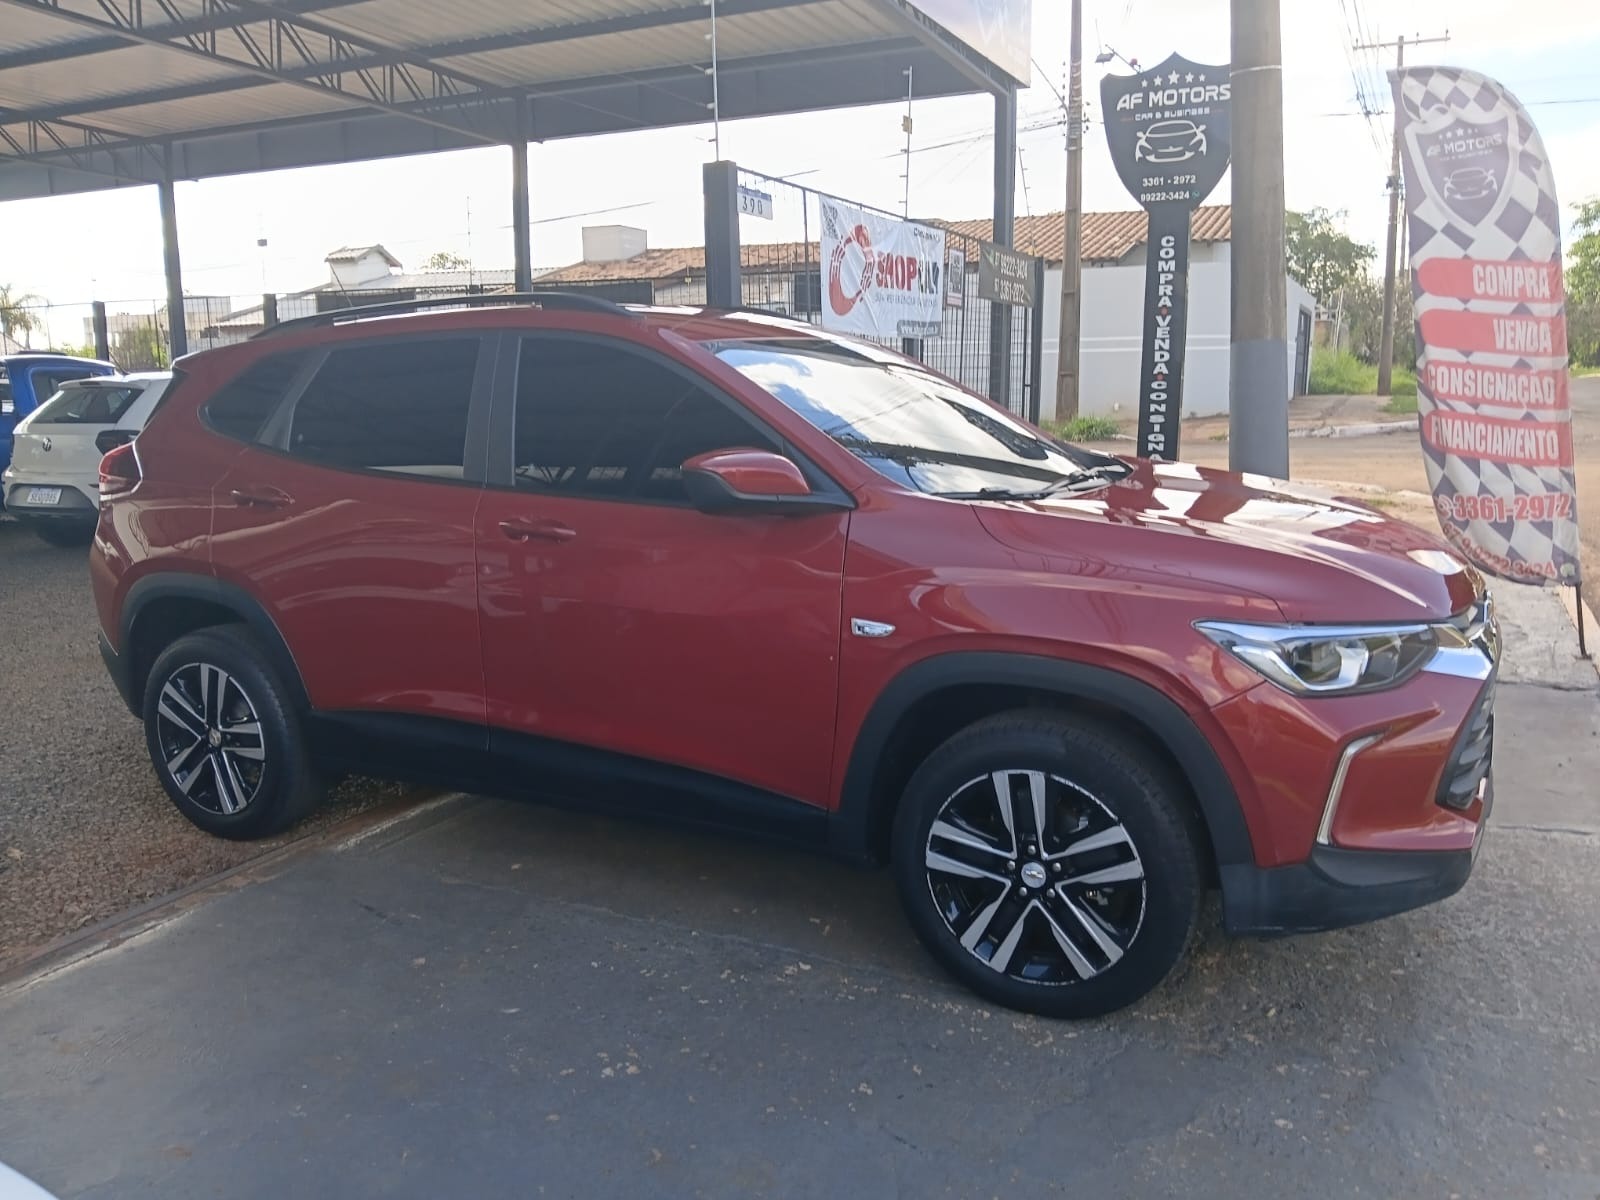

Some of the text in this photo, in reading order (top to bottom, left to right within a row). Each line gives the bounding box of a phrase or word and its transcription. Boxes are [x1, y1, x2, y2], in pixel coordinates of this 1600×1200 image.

[1116, 83, 1232, 112] AF MOTORS
[1135, 112, 1153, 121] CAR
[1443, 133, 1503, 154] MOTORS
[1142, 177, 1164, 187] 3361
[1173, 175, 1196, 185] 2972
[742, 195, 763, 215] 390
[1140, 190, 1190, 203] 99222-3424
[1157, 235, 1176, 307] COMPRA
[1472, 264, 1551, 299] COMPRA
[1153, 315, 1172, 375] VENDA
[1492, 319, 1553, 353] VENDA
[1431, 414, 1560, 460] FINANCIAMENTO
[1453, 493, 1572, 522] 3361-2972
